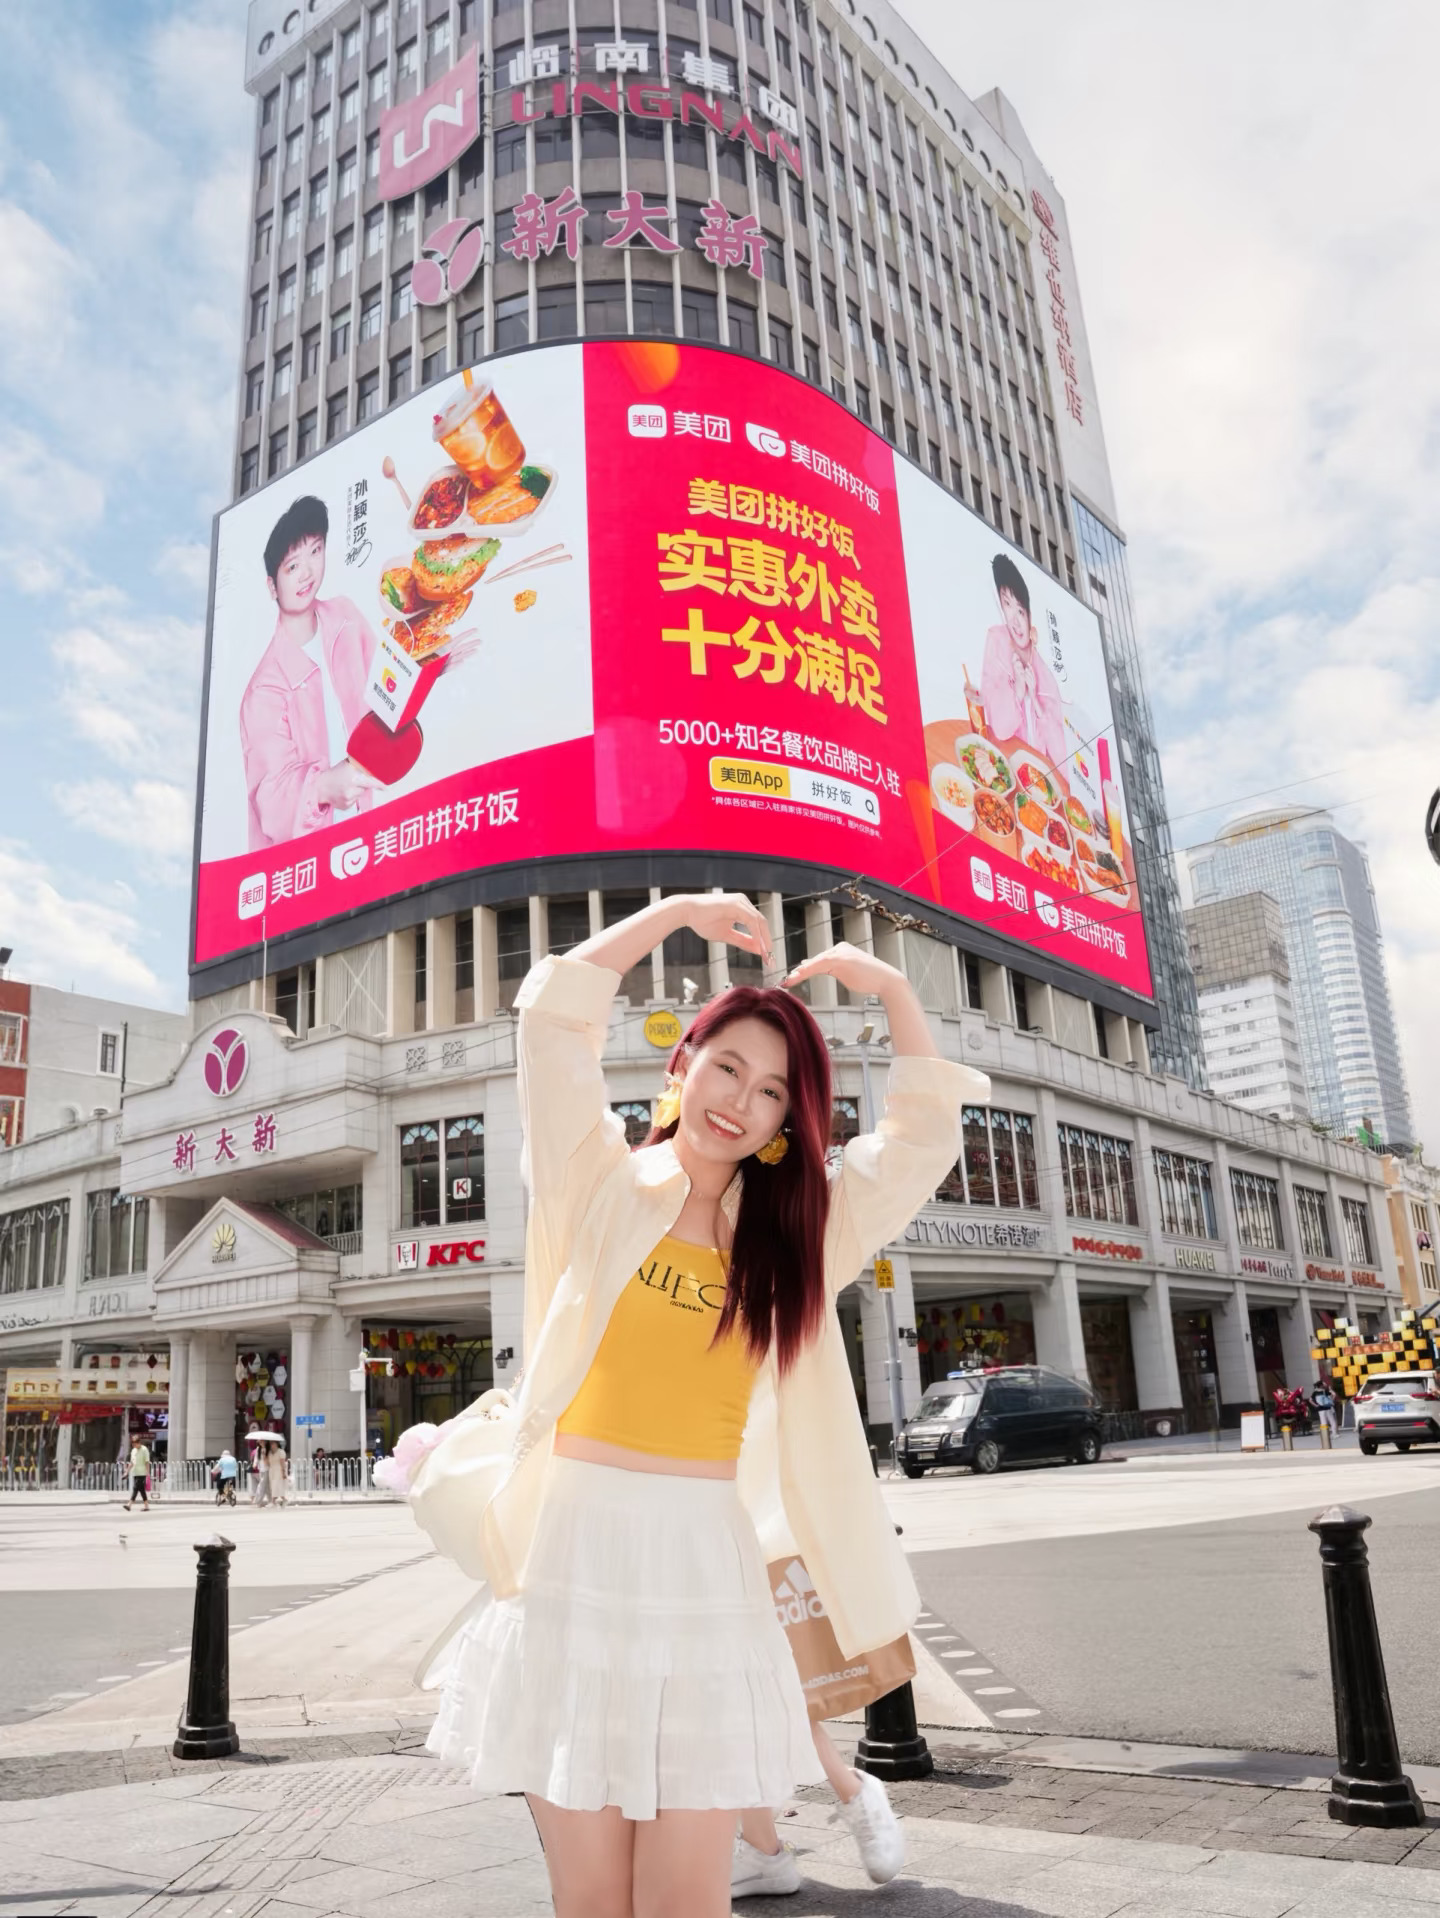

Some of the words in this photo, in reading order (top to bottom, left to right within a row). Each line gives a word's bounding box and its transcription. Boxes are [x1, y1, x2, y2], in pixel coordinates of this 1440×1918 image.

[511, 81, 804, 179] LINGNAN
[501, 186, 769, 281] 新大新
[632, 414, 663, 428] 美团
[674, 411, 731, 443] 美团
[791, 440, 881, 515] 美团拼好饭
[353, 478, 369, 545] 孙颖莎
[657, 529, 882, 651] 实惠外卖
[661, 608, 889, 725] 十分满足
[658, 719, 902, 798] 5000+知名餐饮品牌已入驻
[720, 766, 783, 791] 美团App
[811, 781, 853, 807] 拼好饭
[241, 884, 264, 907] 美团
[270, 856, 317, 905] 美团
[373, 788, 520, 866] 美团拼好饭
[994, 872, 1029, 915] 美团
[1060, 904, 1128, 960] 美团拼好饭
[171, 1112, 280, 1174] 新大新
[426, 1240, 486, 1267] KFC
[1174, 1247, 1216, 1272] HUAWEI
